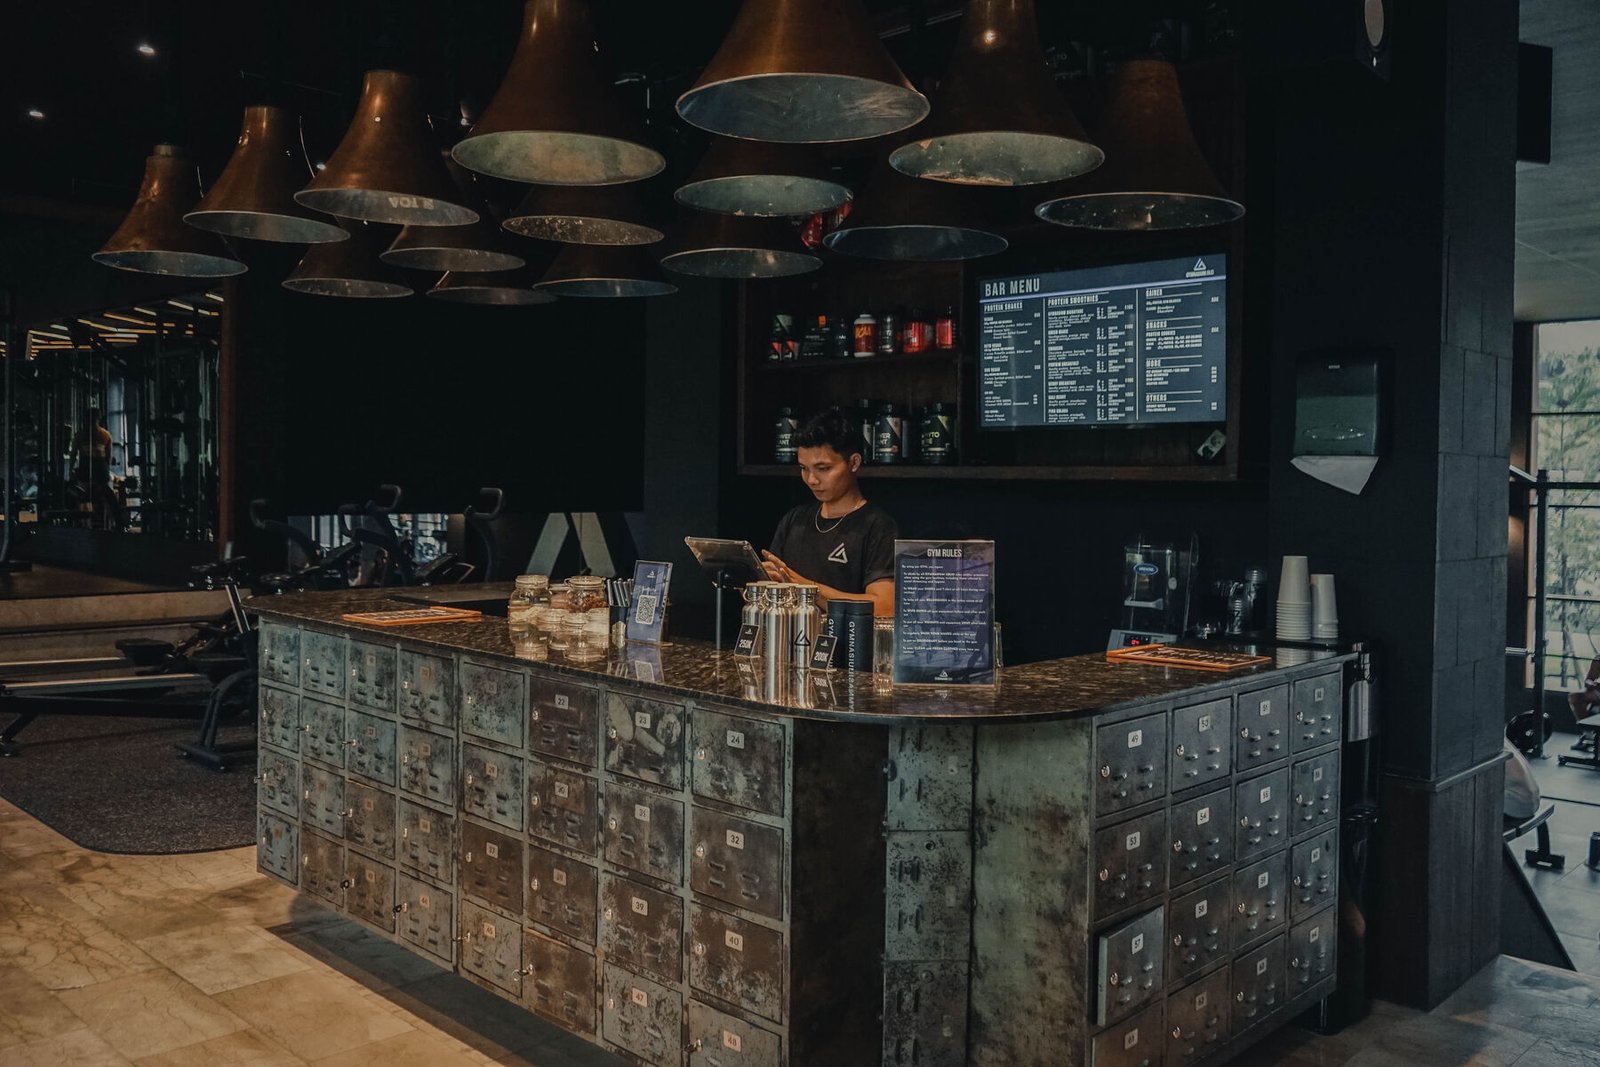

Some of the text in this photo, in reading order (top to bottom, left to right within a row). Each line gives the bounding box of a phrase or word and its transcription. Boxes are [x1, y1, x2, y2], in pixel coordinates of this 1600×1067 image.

[985, 278, 1040, 296] BAR MENU
[1048, 296, 1069, 306] PROTEIN
[984, 304, 1003, 312] PROTEIN
[1146, 320, 1167, 329] SNACKS
[927, 549, 962, 557] GYM RULES
[739, 640, 752, 649] 250K
[814, 651, 829, 662] 200K
